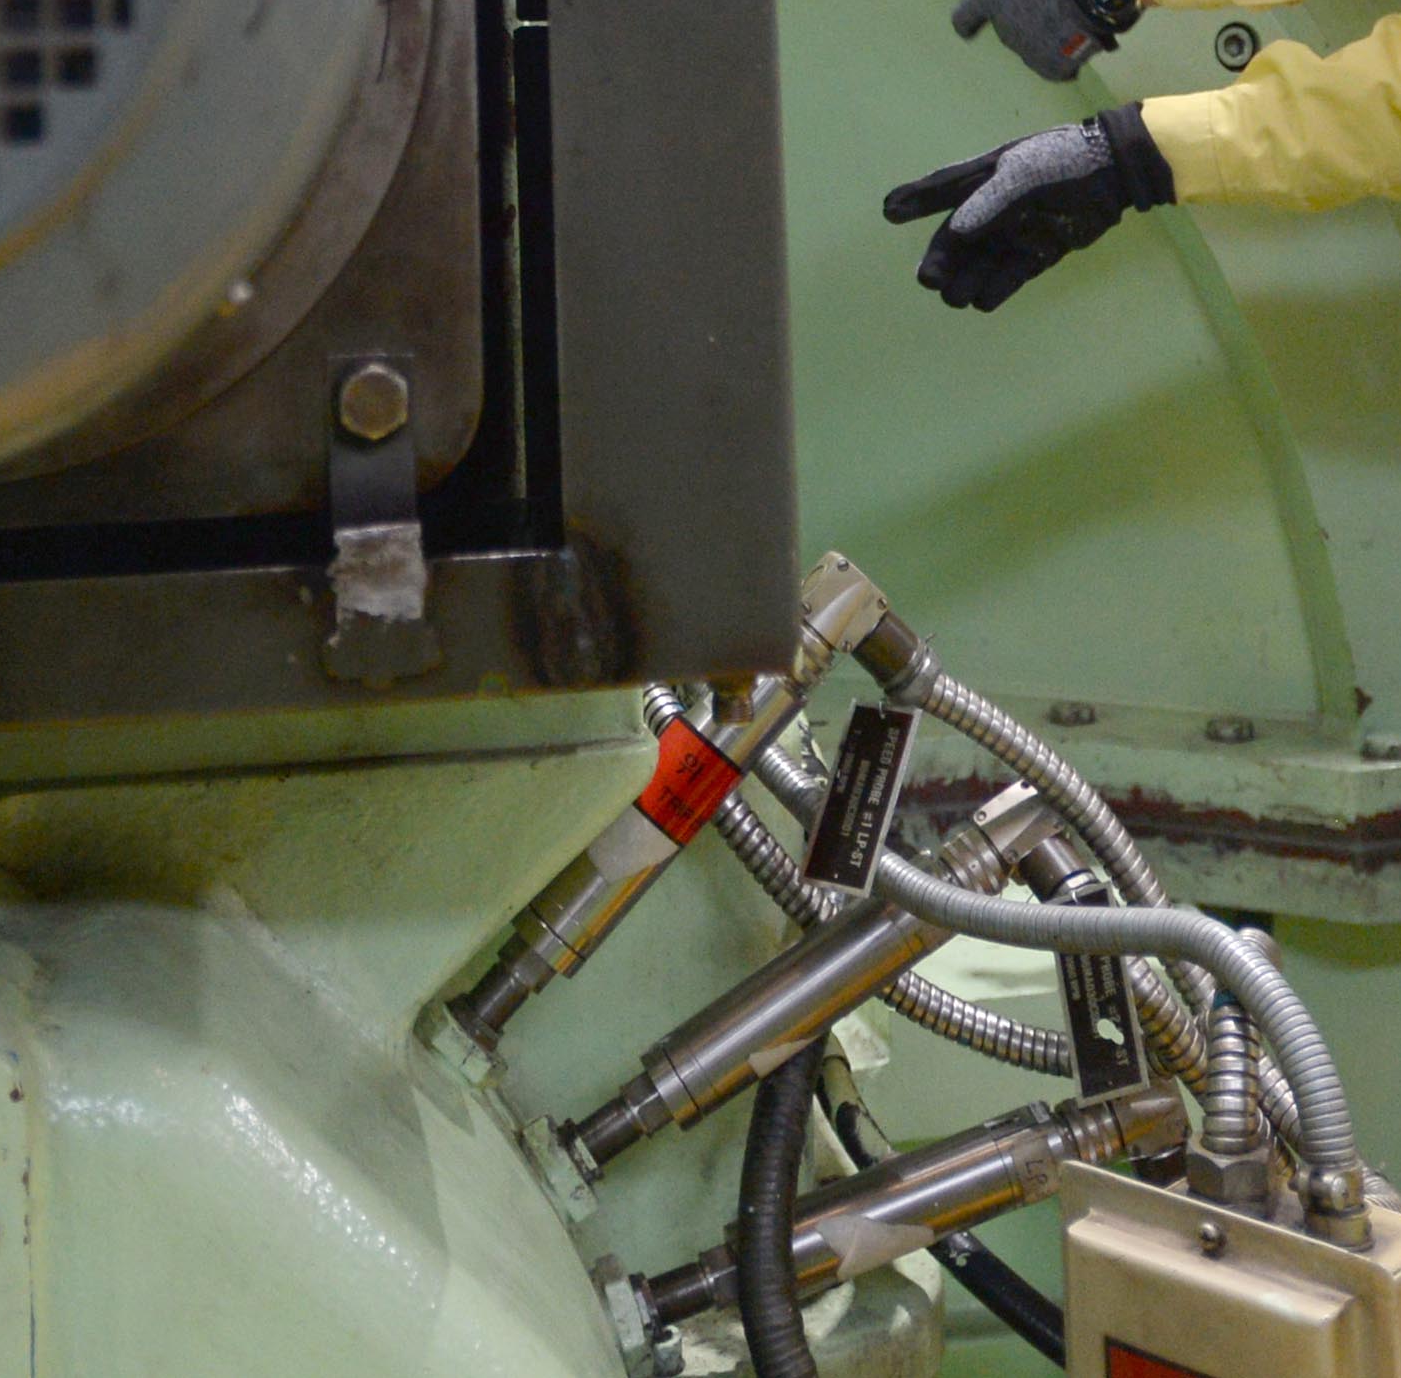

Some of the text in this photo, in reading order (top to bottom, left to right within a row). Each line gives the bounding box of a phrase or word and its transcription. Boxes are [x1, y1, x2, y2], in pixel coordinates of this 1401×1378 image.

[880, 727, 899, 765] SPEED
[868, 769, 888, 806] PROBE
[850, 832, 870, 868] LP-ST
